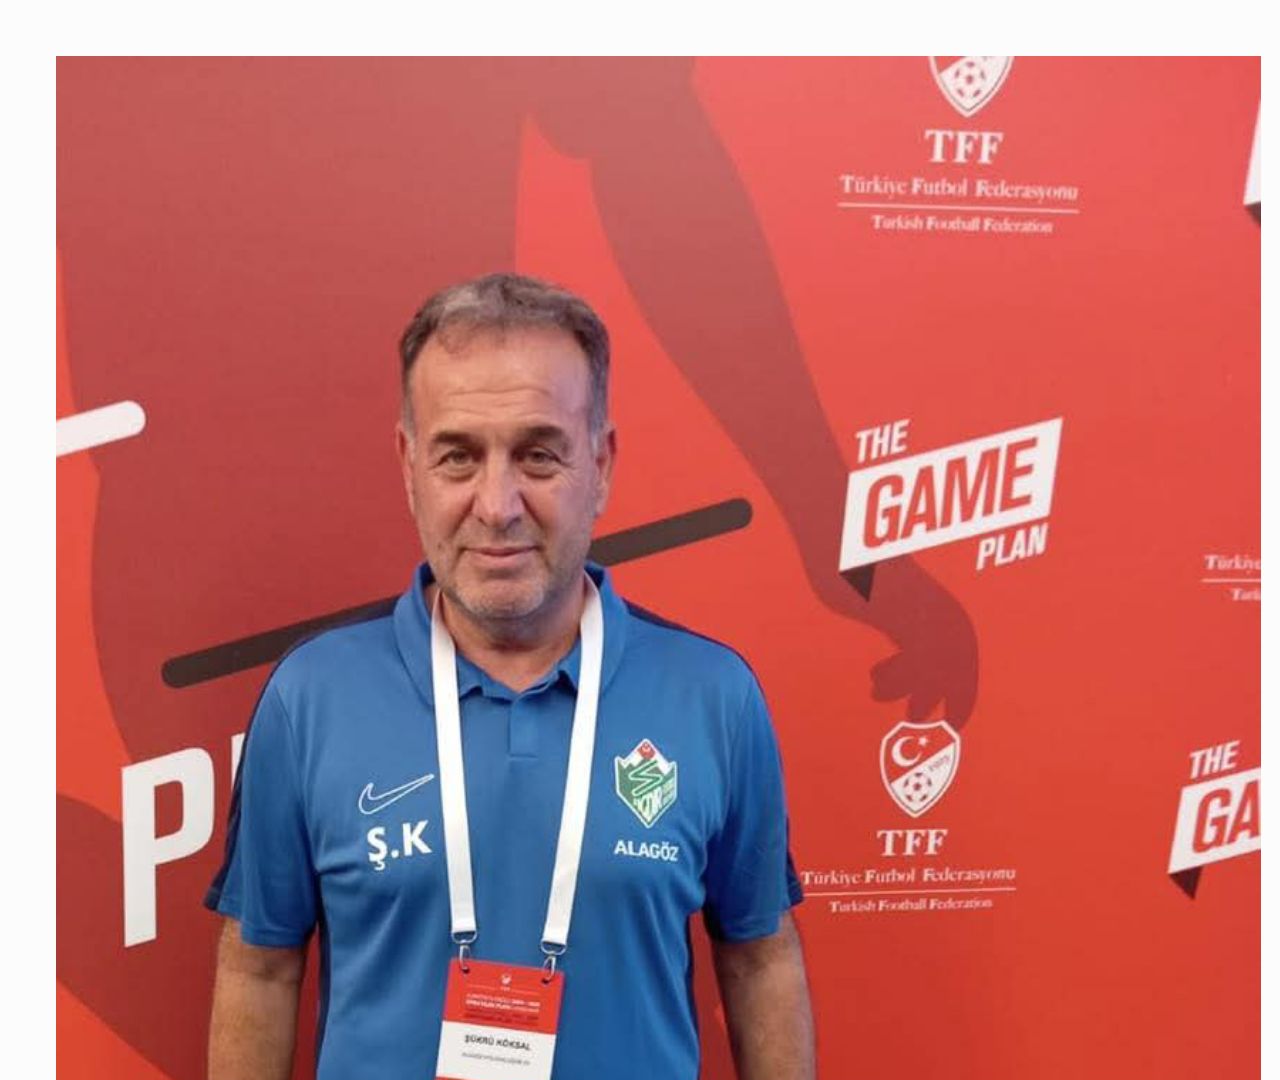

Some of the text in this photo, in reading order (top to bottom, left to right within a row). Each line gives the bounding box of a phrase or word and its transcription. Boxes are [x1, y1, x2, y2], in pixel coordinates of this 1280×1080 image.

[925, 129, 1004, 164] TFF
[840, 175, 1079, 204] Türkiye Futbol Federasyonu
[855, 419, 911, 464] THE
[863, 436, 1038, 549] GAME
[976, 522, 1049, 571] PLAN
[1190, 739, 1241, 780] THE
[366, 820, 433, 871] Ş.K
[614, 839, 680, 861] ALAGÖZ
[876, 829, 948, 856] TFF
[801, 867, 1017, 887] Türkiye Futbol Federasyonu
